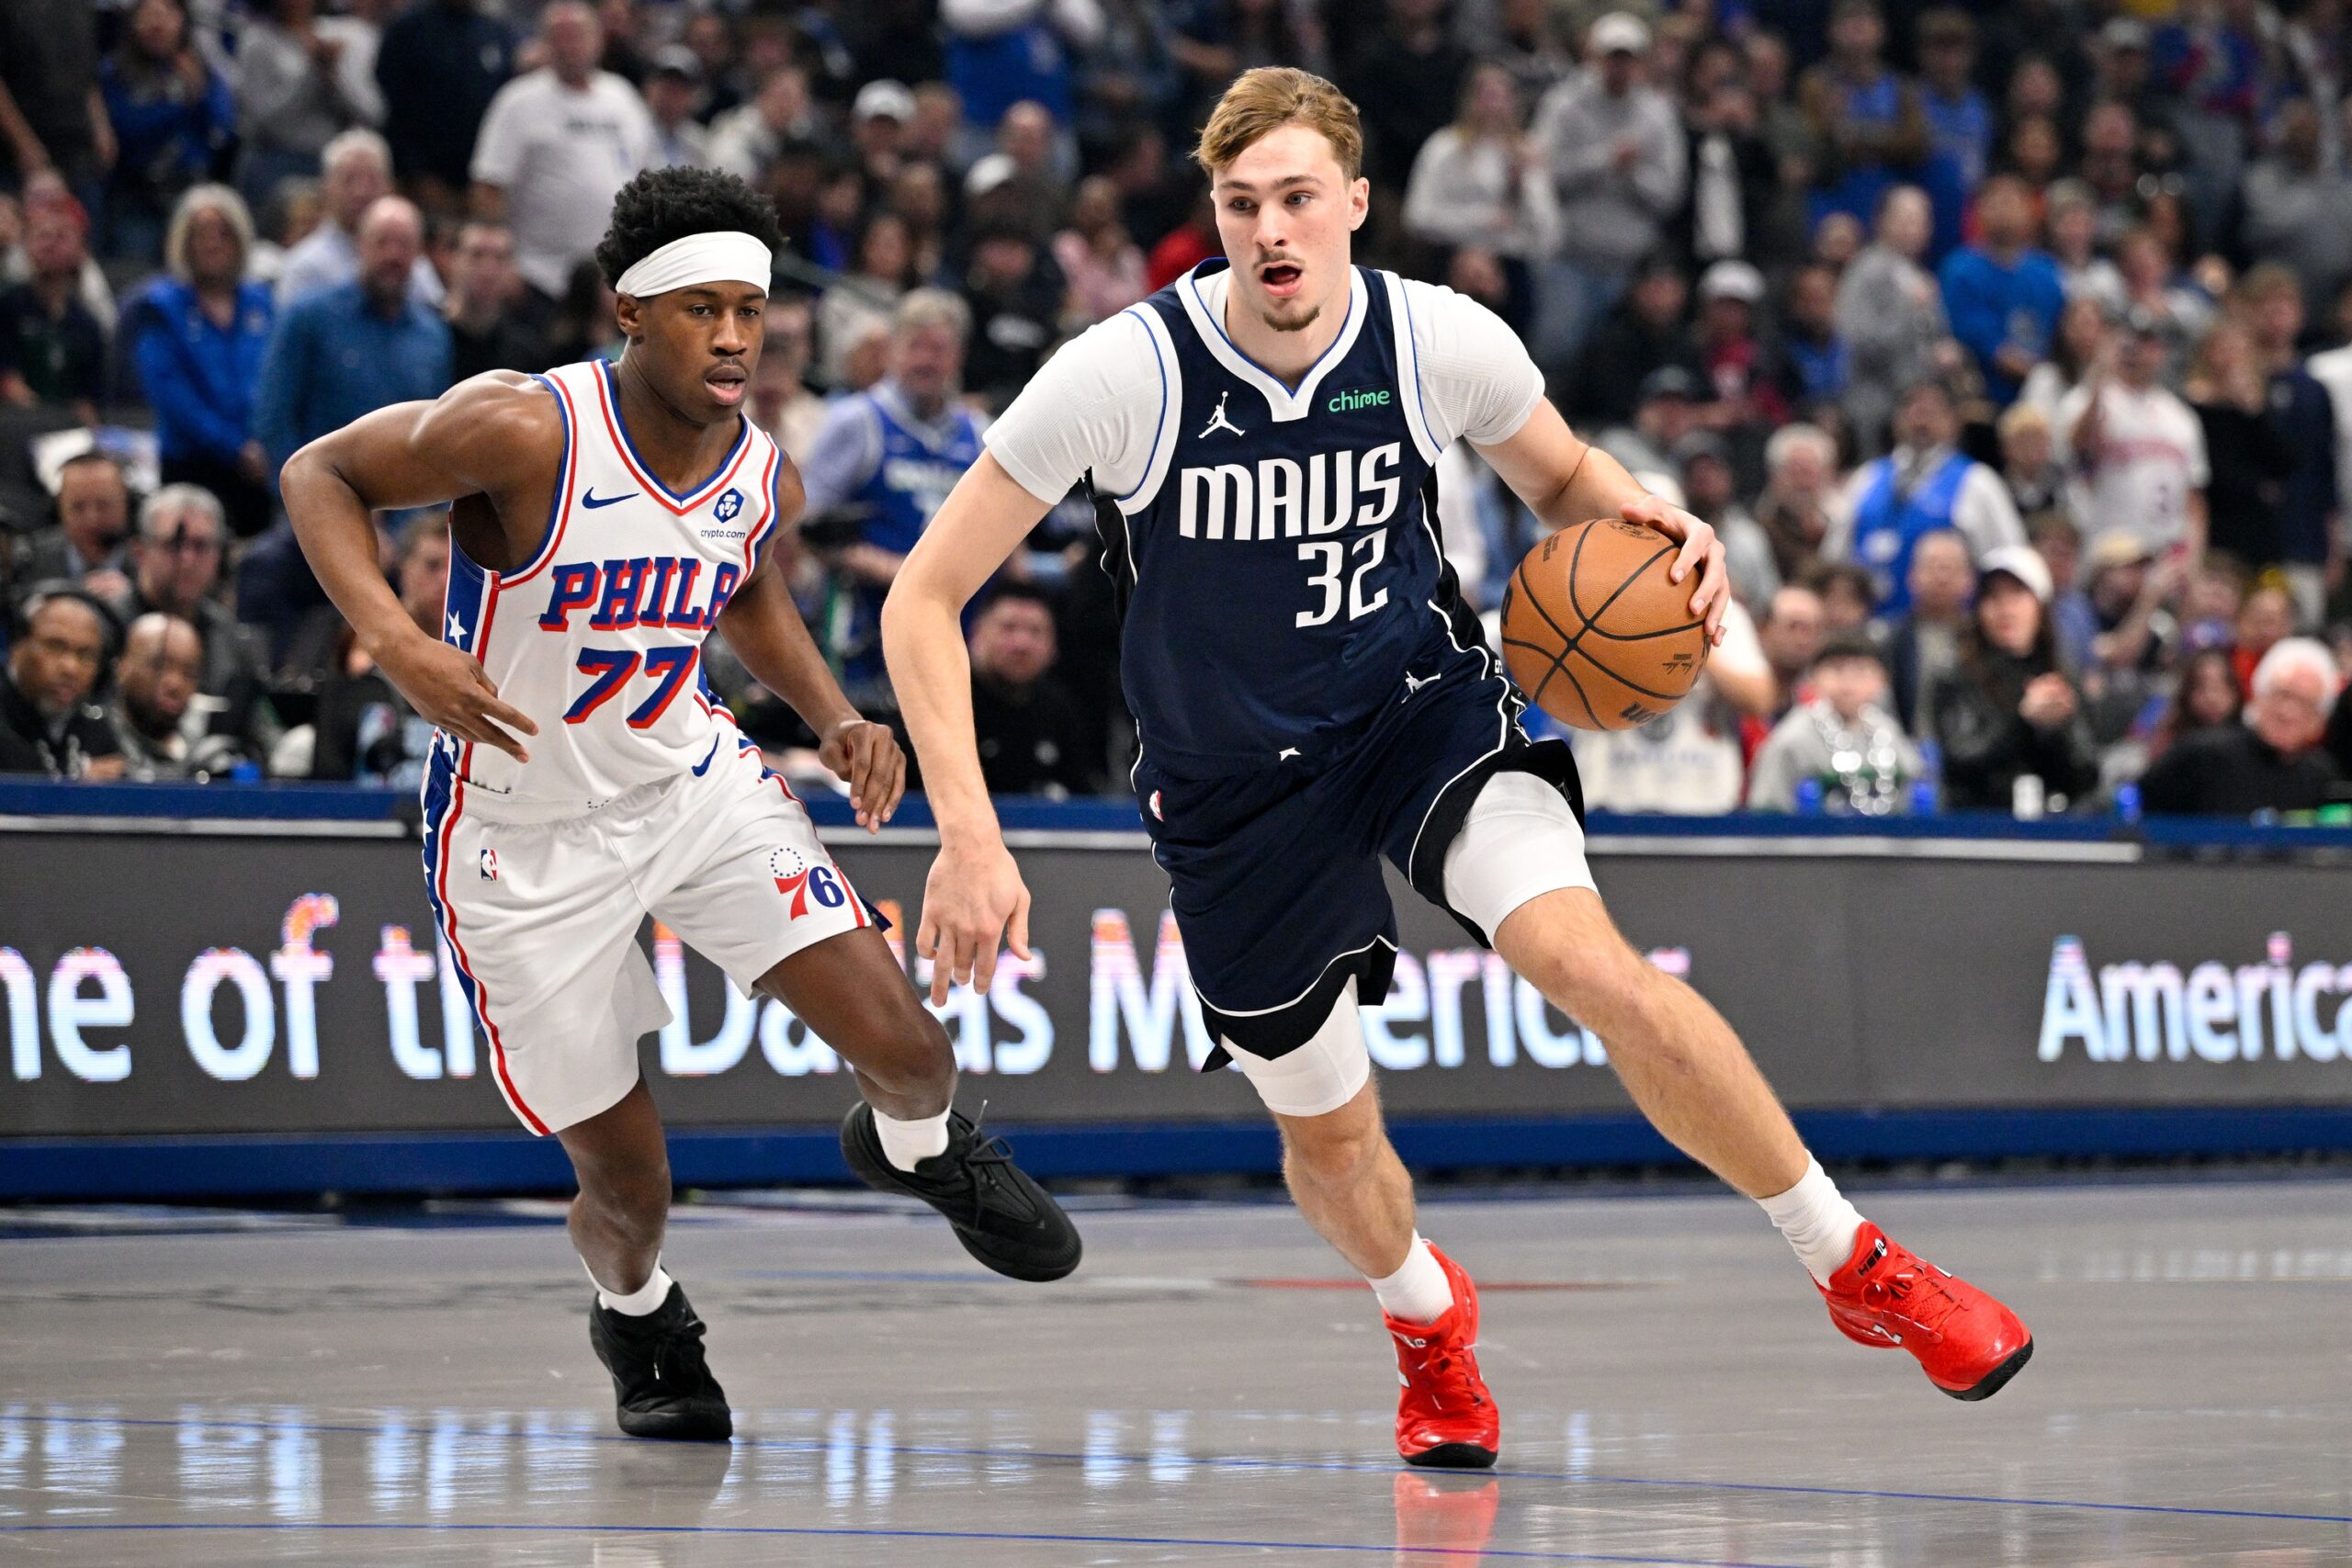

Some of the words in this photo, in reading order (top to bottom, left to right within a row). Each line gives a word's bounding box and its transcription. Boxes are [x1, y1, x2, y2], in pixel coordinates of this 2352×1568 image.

[1329, 389, 1390, 412] chime
[700, 529, 746, 539] crypto.com
[1295, 527, 1388, 627] 32
[562, 646, 699, 728] 77
[773, 866, 845, 921] 76
[180, 893, 339, 1081] of
